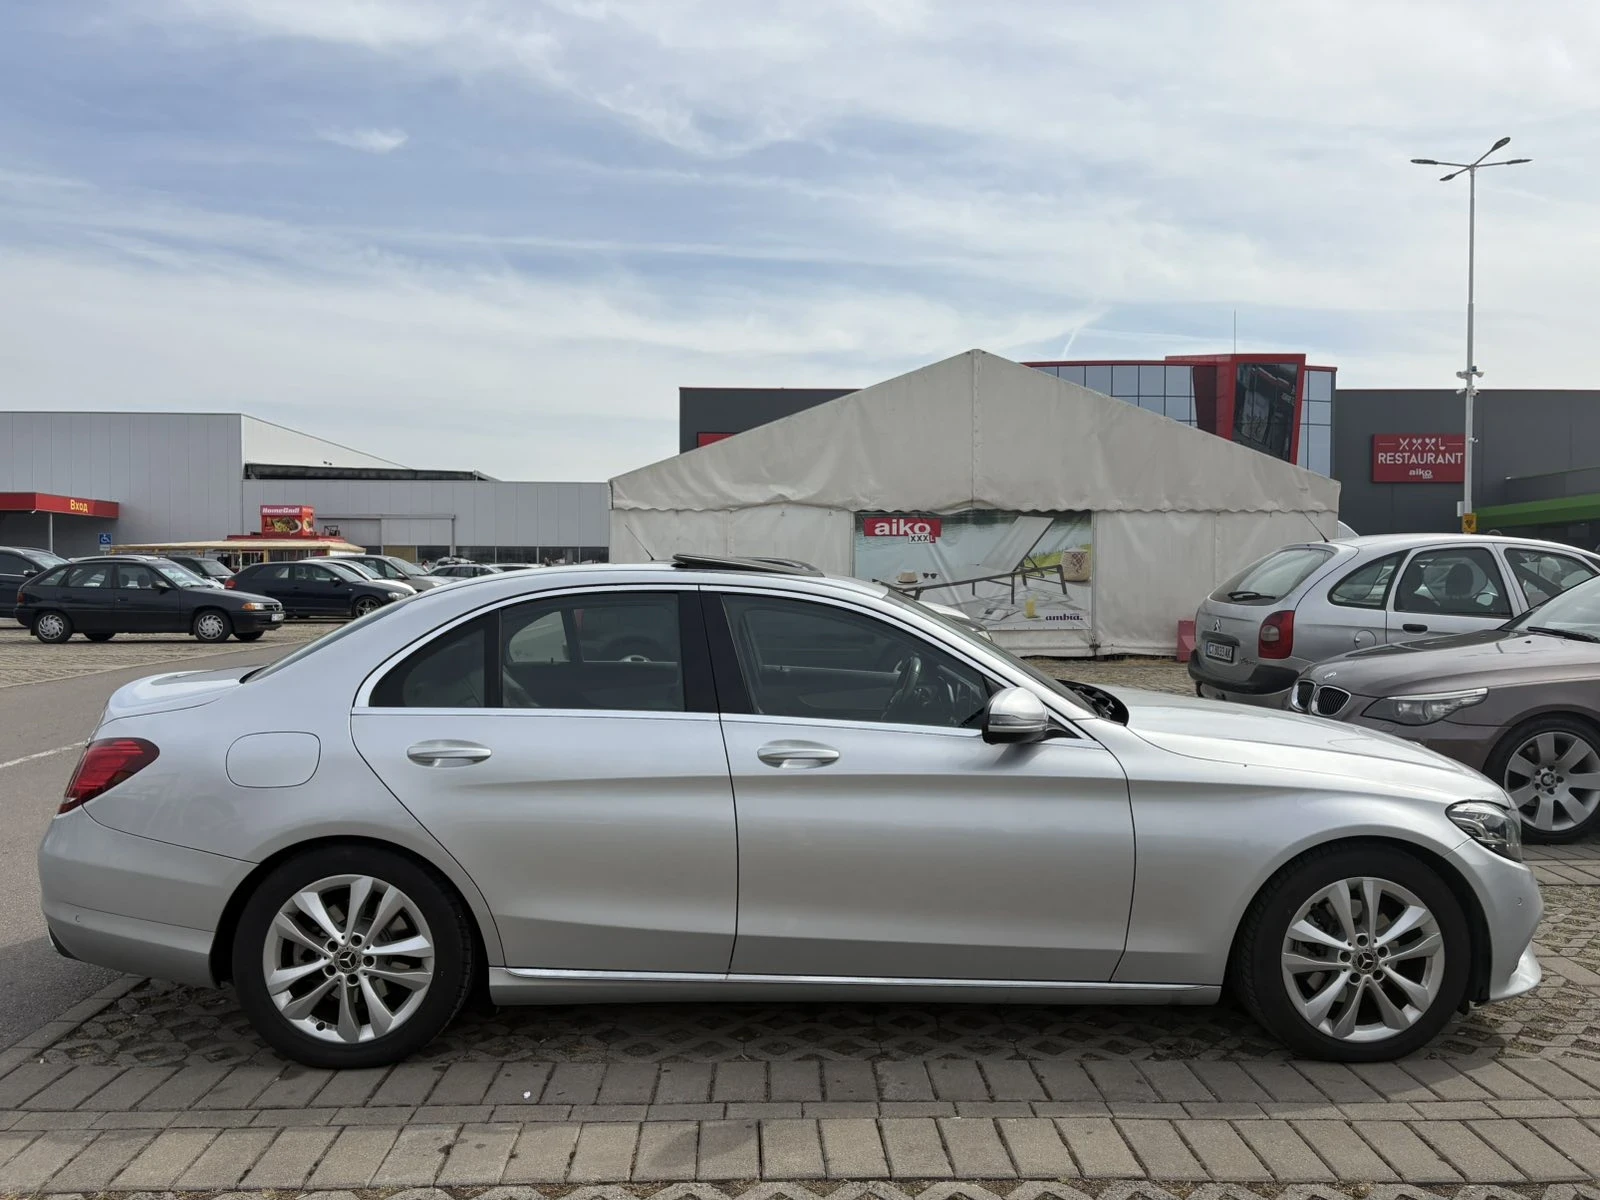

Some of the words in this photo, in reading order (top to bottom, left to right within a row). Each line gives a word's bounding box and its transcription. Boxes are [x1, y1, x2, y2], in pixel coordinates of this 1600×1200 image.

[1378, 452, 1463, 464] RESTAURANT
[1409, 468, 1432, 476] aiko
[70, 499, 88, 513] Вход
[874, 518, 931, 536] aiko
